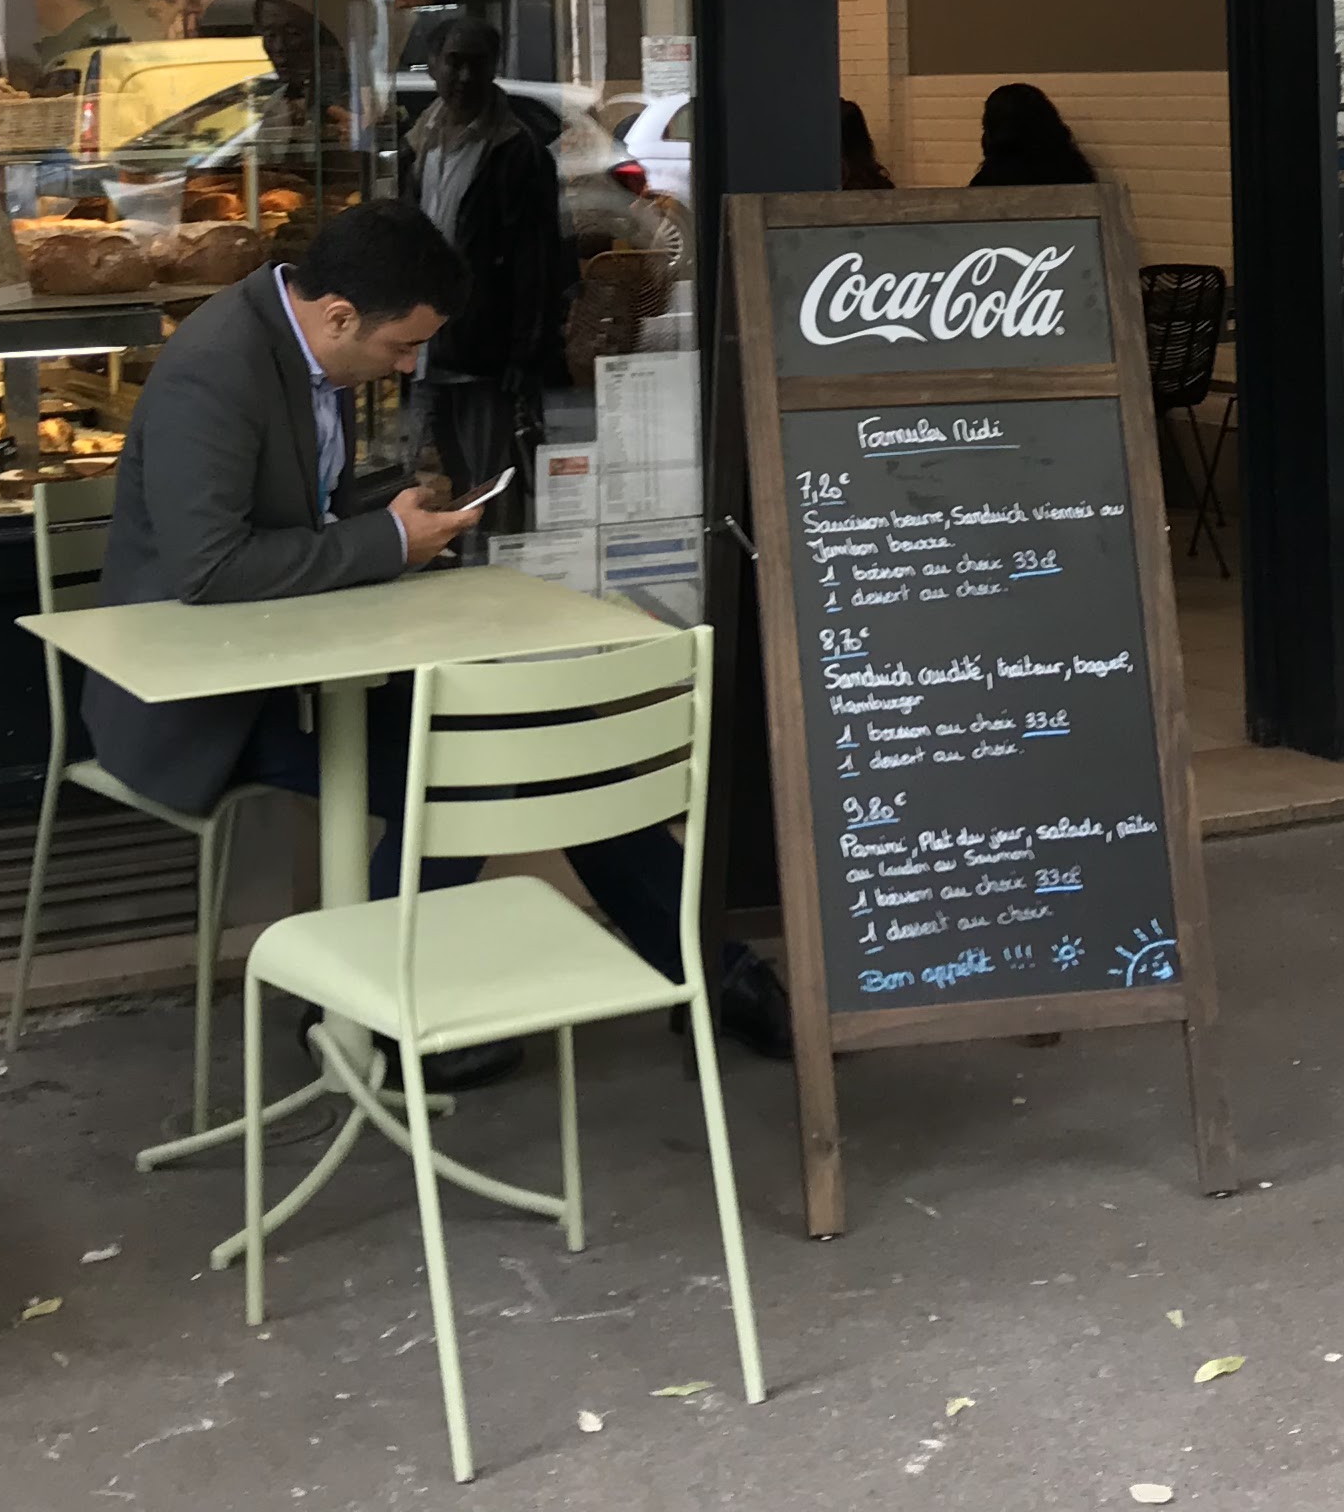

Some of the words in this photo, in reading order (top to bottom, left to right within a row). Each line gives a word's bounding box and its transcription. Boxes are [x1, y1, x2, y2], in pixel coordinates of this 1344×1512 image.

[799, 244, 1076, 346] Coca-Cola
[819, 565, 837, 583] 1
[922, 560, 952, 576] au
[824, 590, 838, 608] 1
[919, 587, 950, 602] au
[823, 661, 914, 690] Sandwich
[836, 723, 852, 745] 1
[935, 721, 967, 736] au
[837, 754, 854, 771] 1
[932, 747, 966, 763] au
[955, 826, 986, 846] du
[848, 890, 868, 912] 1
[940, 885, 972, 901] au
[858, 921, 878, 944] 1
[957, 916, 991, 932] au
[857, 968, 916, 993] Bon
